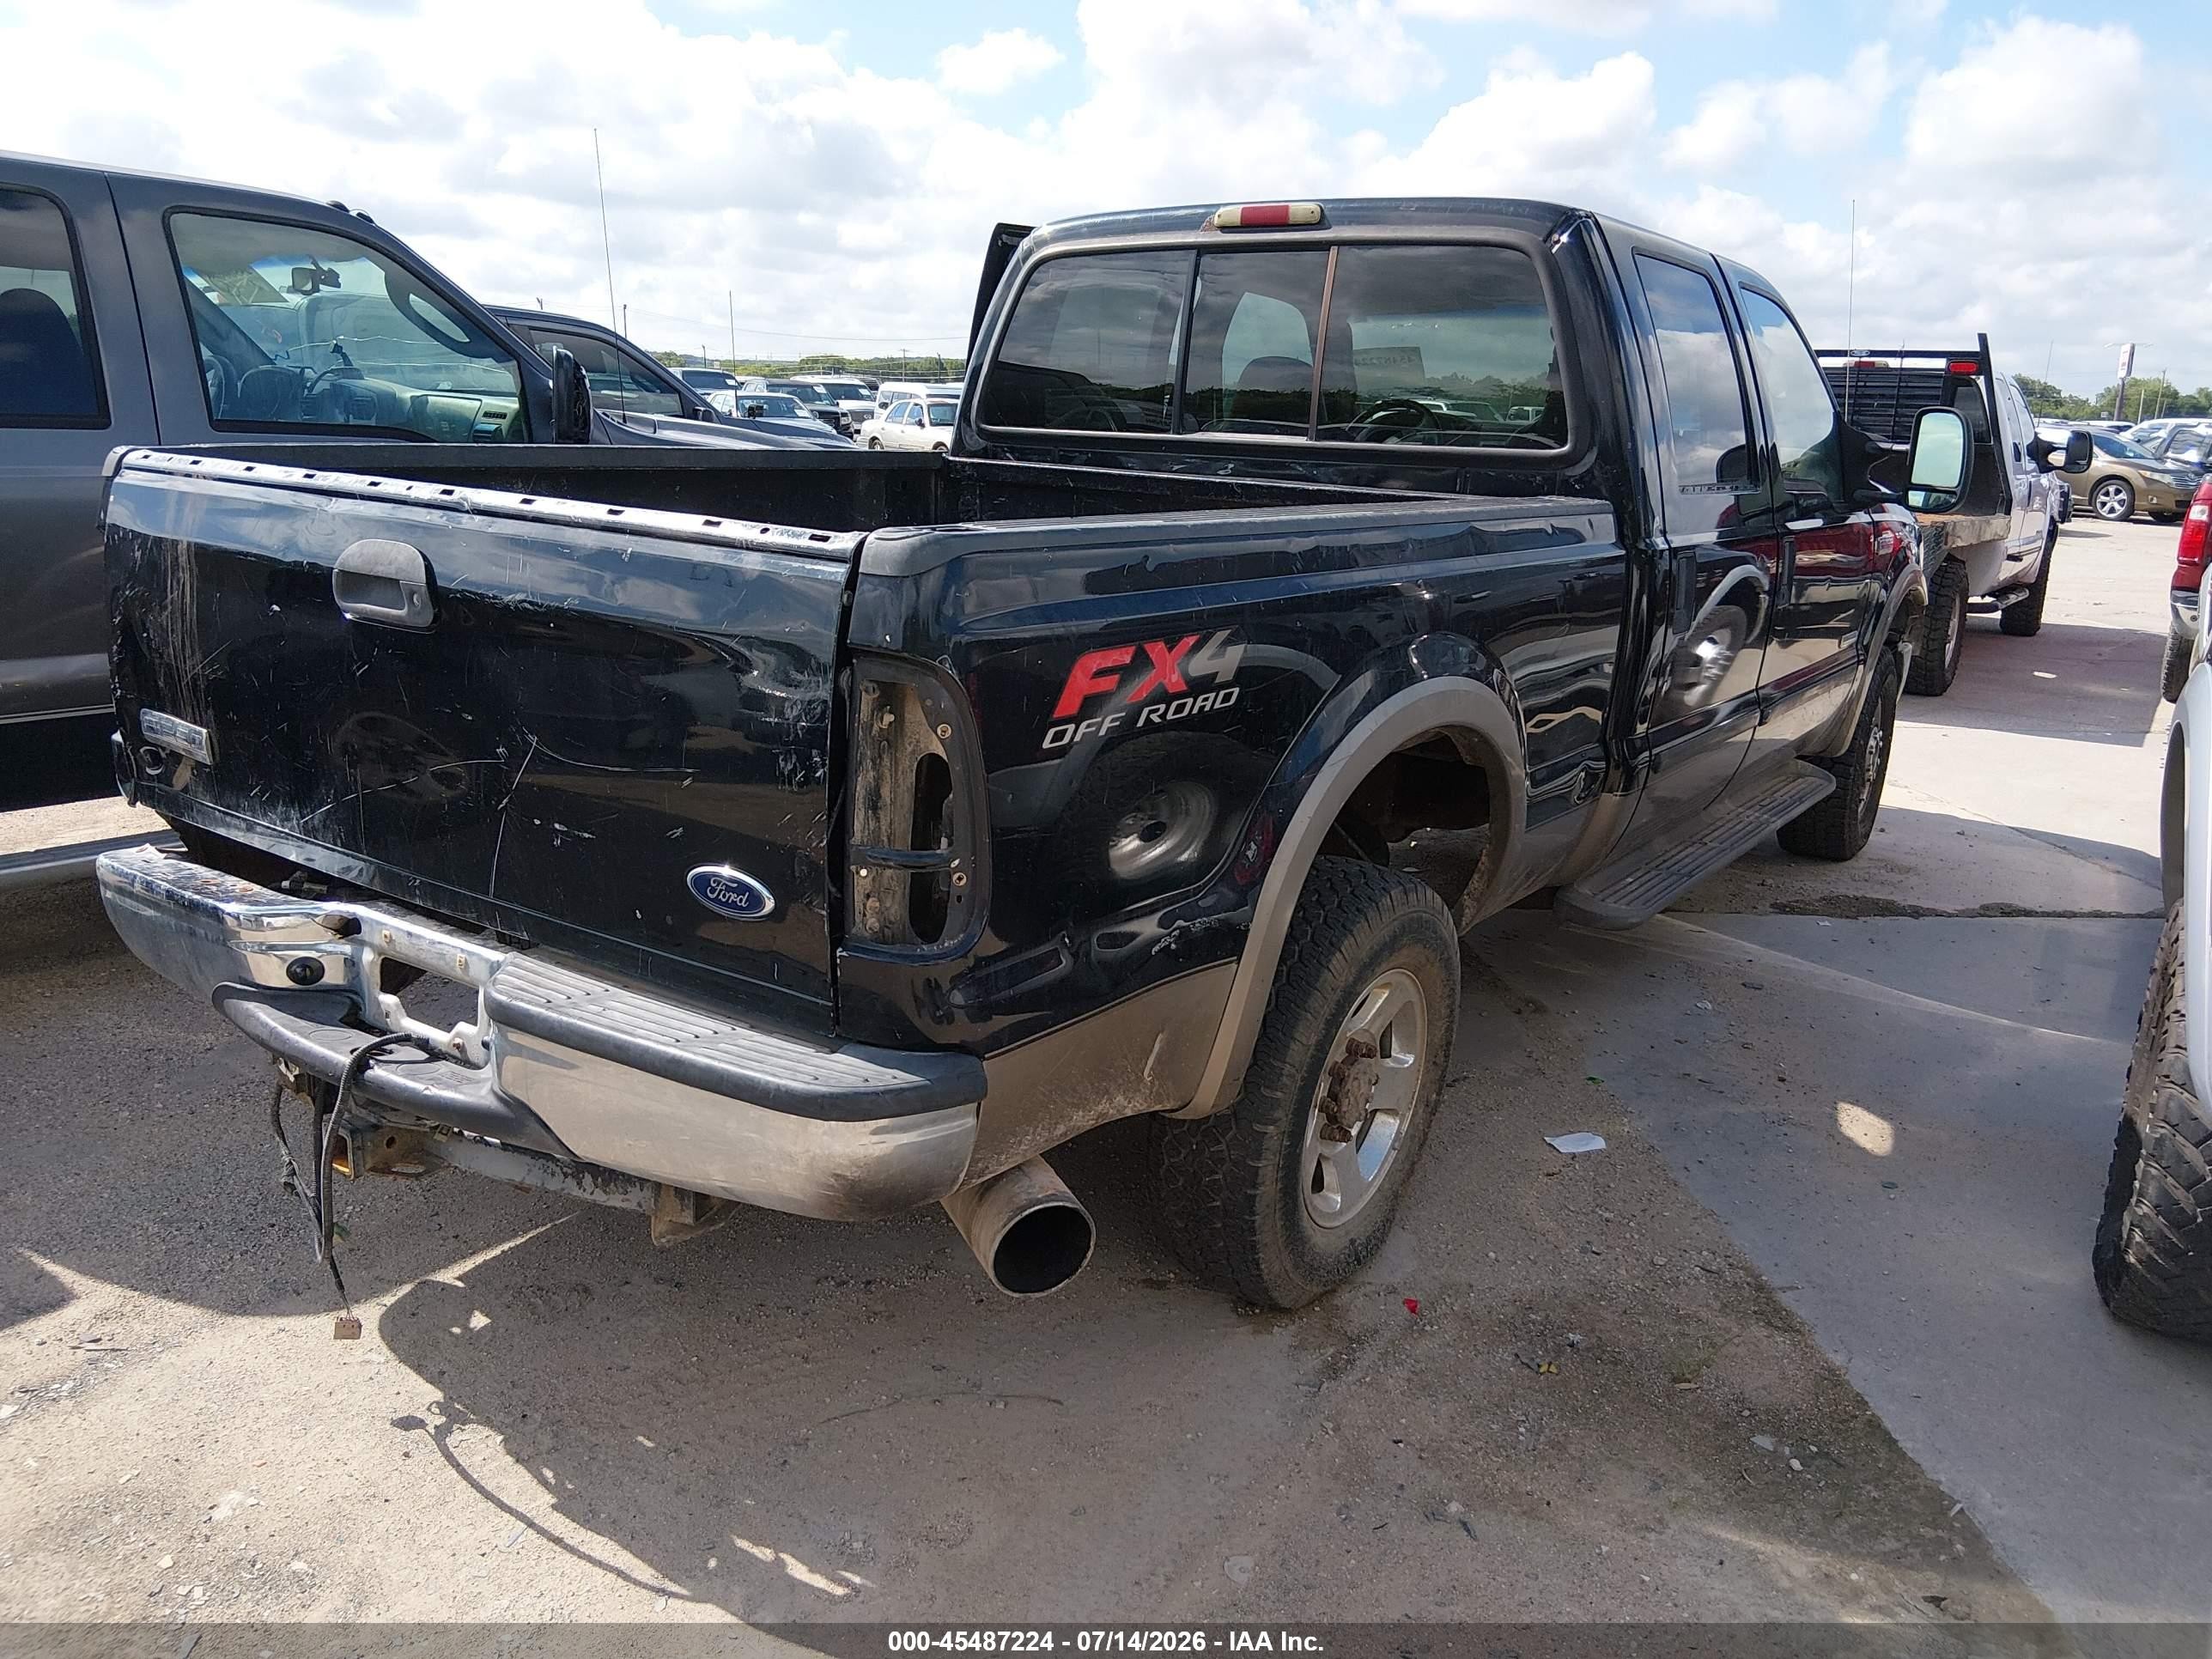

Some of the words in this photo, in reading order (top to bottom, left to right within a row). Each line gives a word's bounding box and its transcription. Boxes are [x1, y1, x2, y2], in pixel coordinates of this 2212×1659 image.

[1053, 626, 1245, 719] FX4
[1042, 712, 1126, 750] OFF
[1136, 686, 1240, 727] ROAD
[707, 877, 750, 908] Ford
